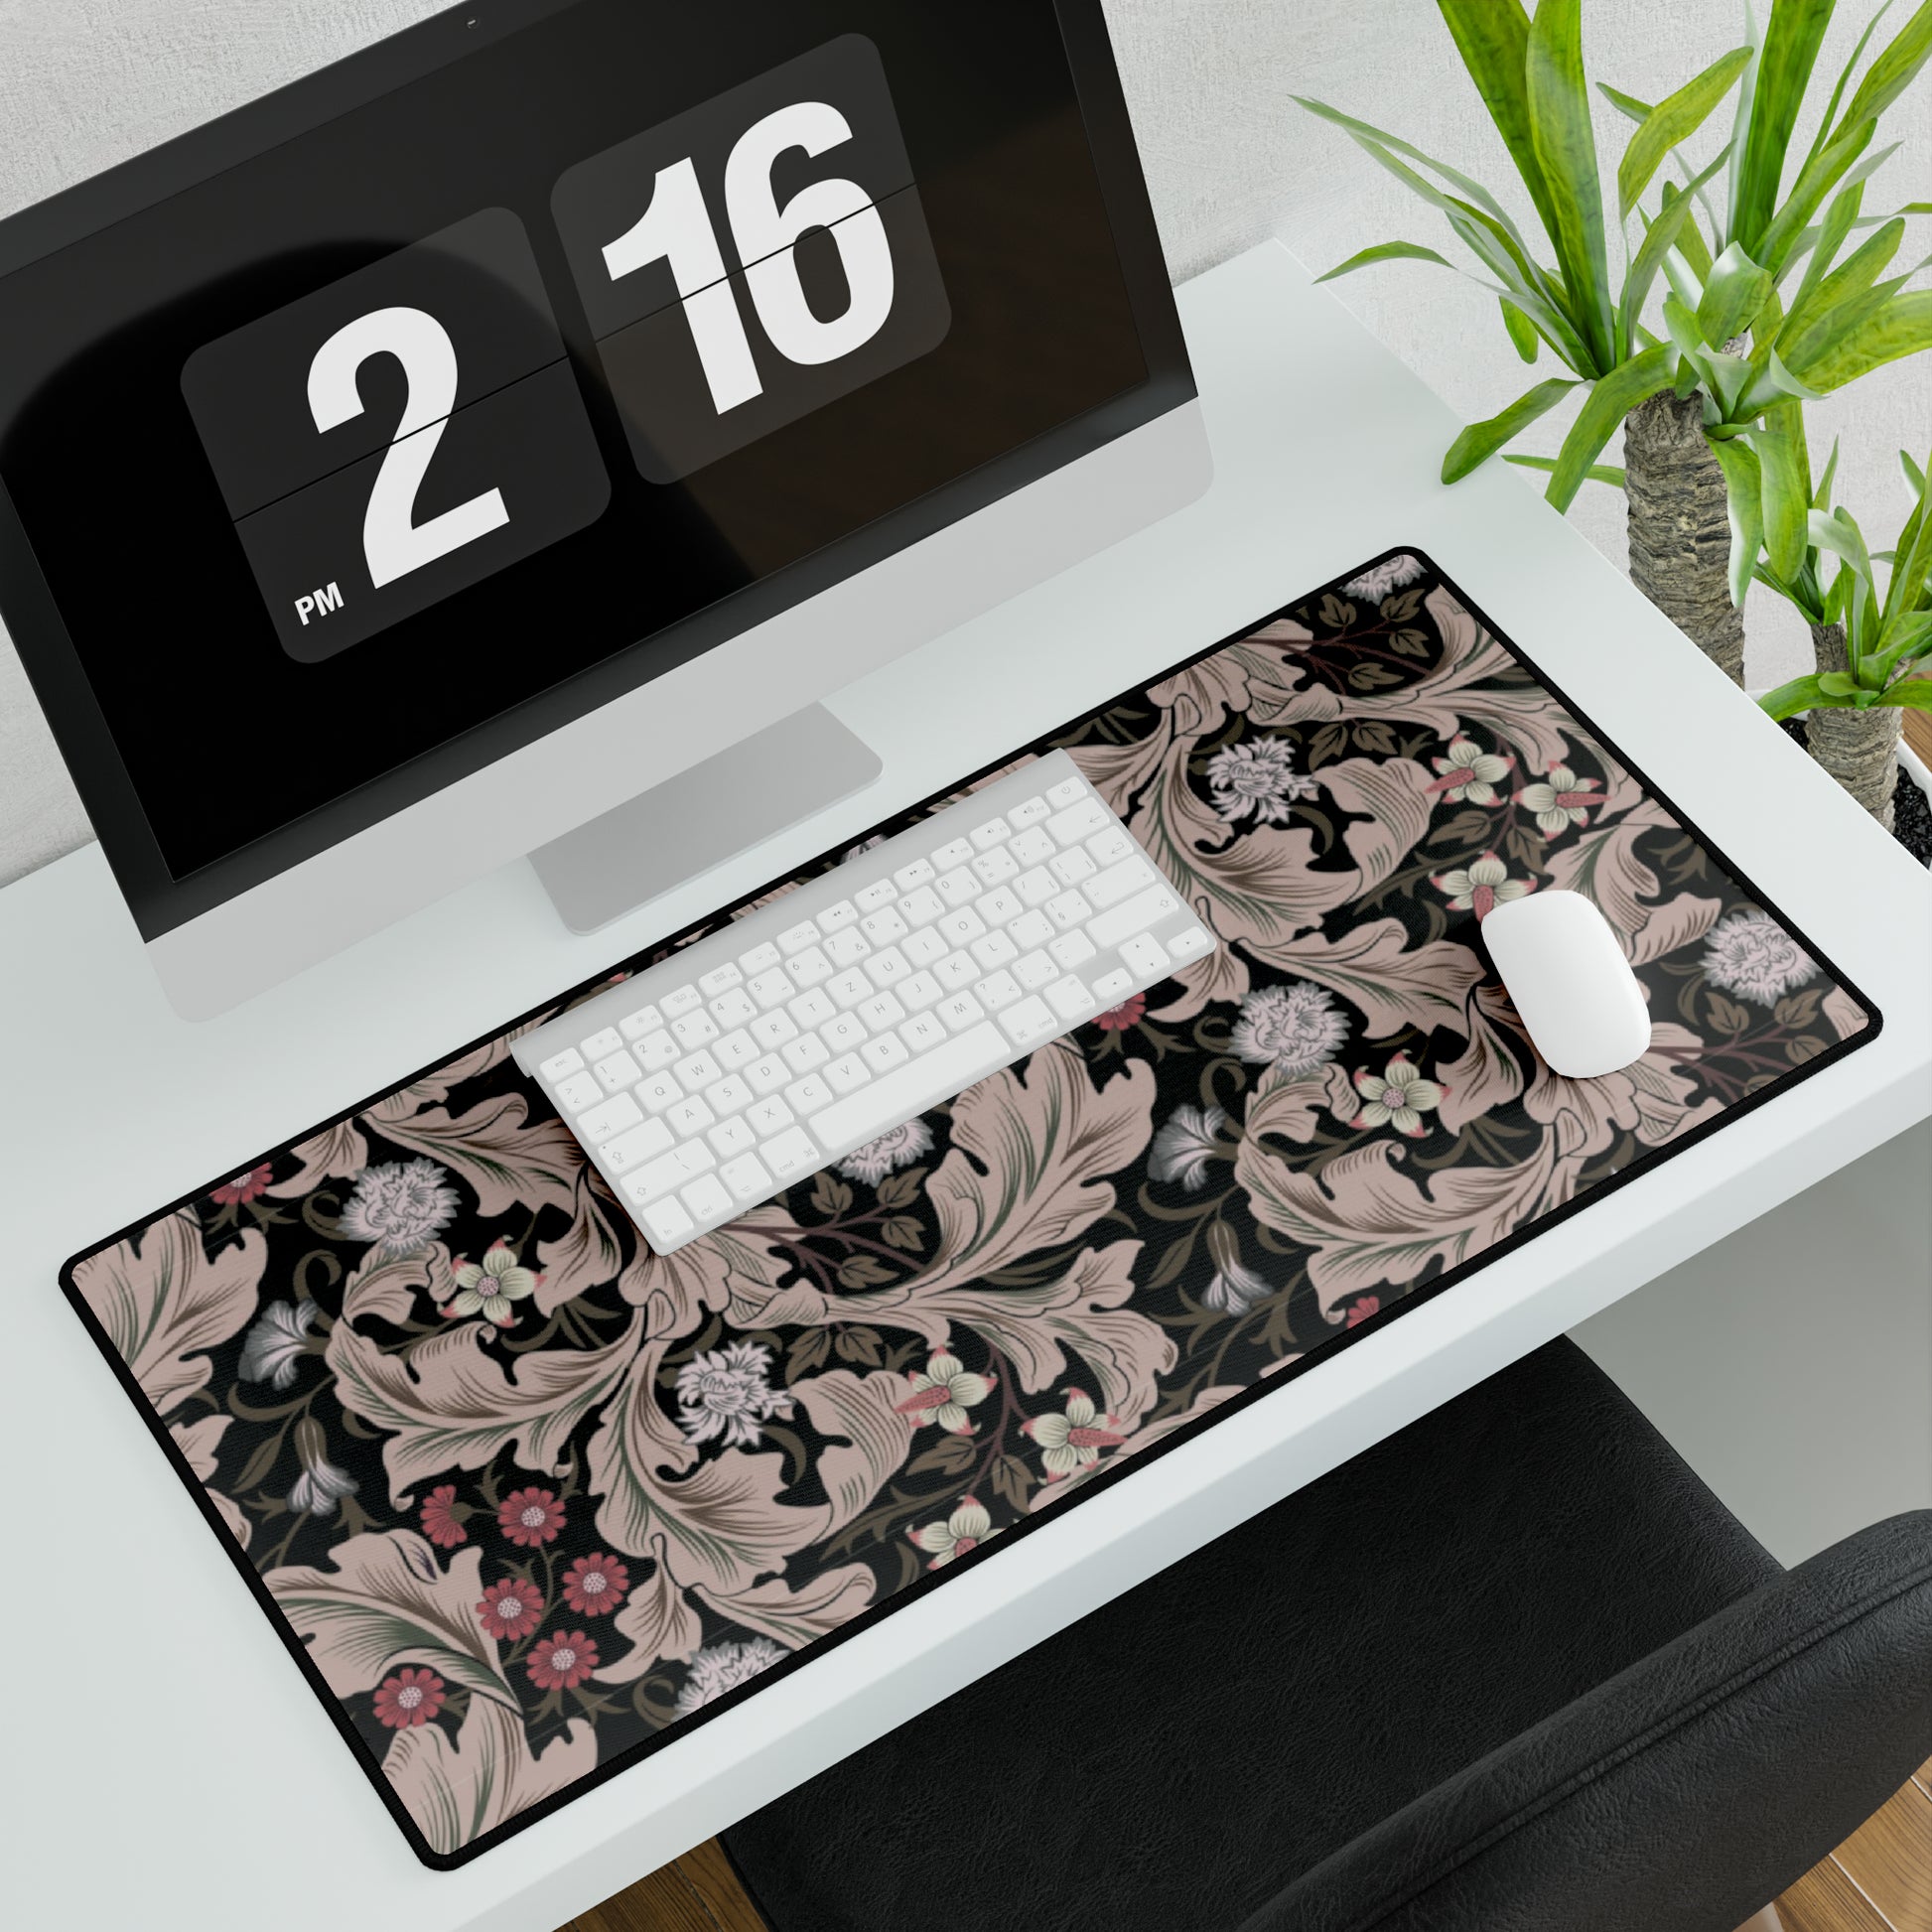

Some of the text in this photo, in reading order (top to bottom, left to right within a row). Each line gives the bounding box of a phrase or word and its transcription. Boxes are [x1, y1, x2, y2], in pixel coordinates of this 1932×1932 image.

[308, 102, 894, 589] 2 16
[295, 582, 344, 625] PM
[639, 1044, 647, 1053] 2
[677, 1024, 685, 1033] 3
[755, 982, 761, 991] 5
[793, 962, 800, 971] 6
[829, 941, 835, 950] 7
[655, 1087, 665, 1096] Q
[691, 1064, 704, 1075] W
[733, 1044, 741, 1054] E
[808, 1003, 815, 1012] T
[846, 982, 856, 992] Z
[883, 962, 893, 971] U
[958, 921, 968, 930] O
[996, 901, 1003, 910] P
[685, 1109, 694, 1119] A
[760, 1066, 770, 1076] D
[799, 1045, 806, 1054] F
[837, 1025, 847, 1034] G
[875, 1004, 886, 1014] H
[915, 984, 921, 993] J
[950, 962, 961, 972] K
[726, 1129, 734, 1138] Y
[763, 1108, 775, 1118] X
[803, 1087, 813, 1096] C
[841, 1065, 850, 1075] V
[879, 1045, 889, 1054] B
[916, 1024, 927, 1035] N
[954, 1003, 967, 1014] M
